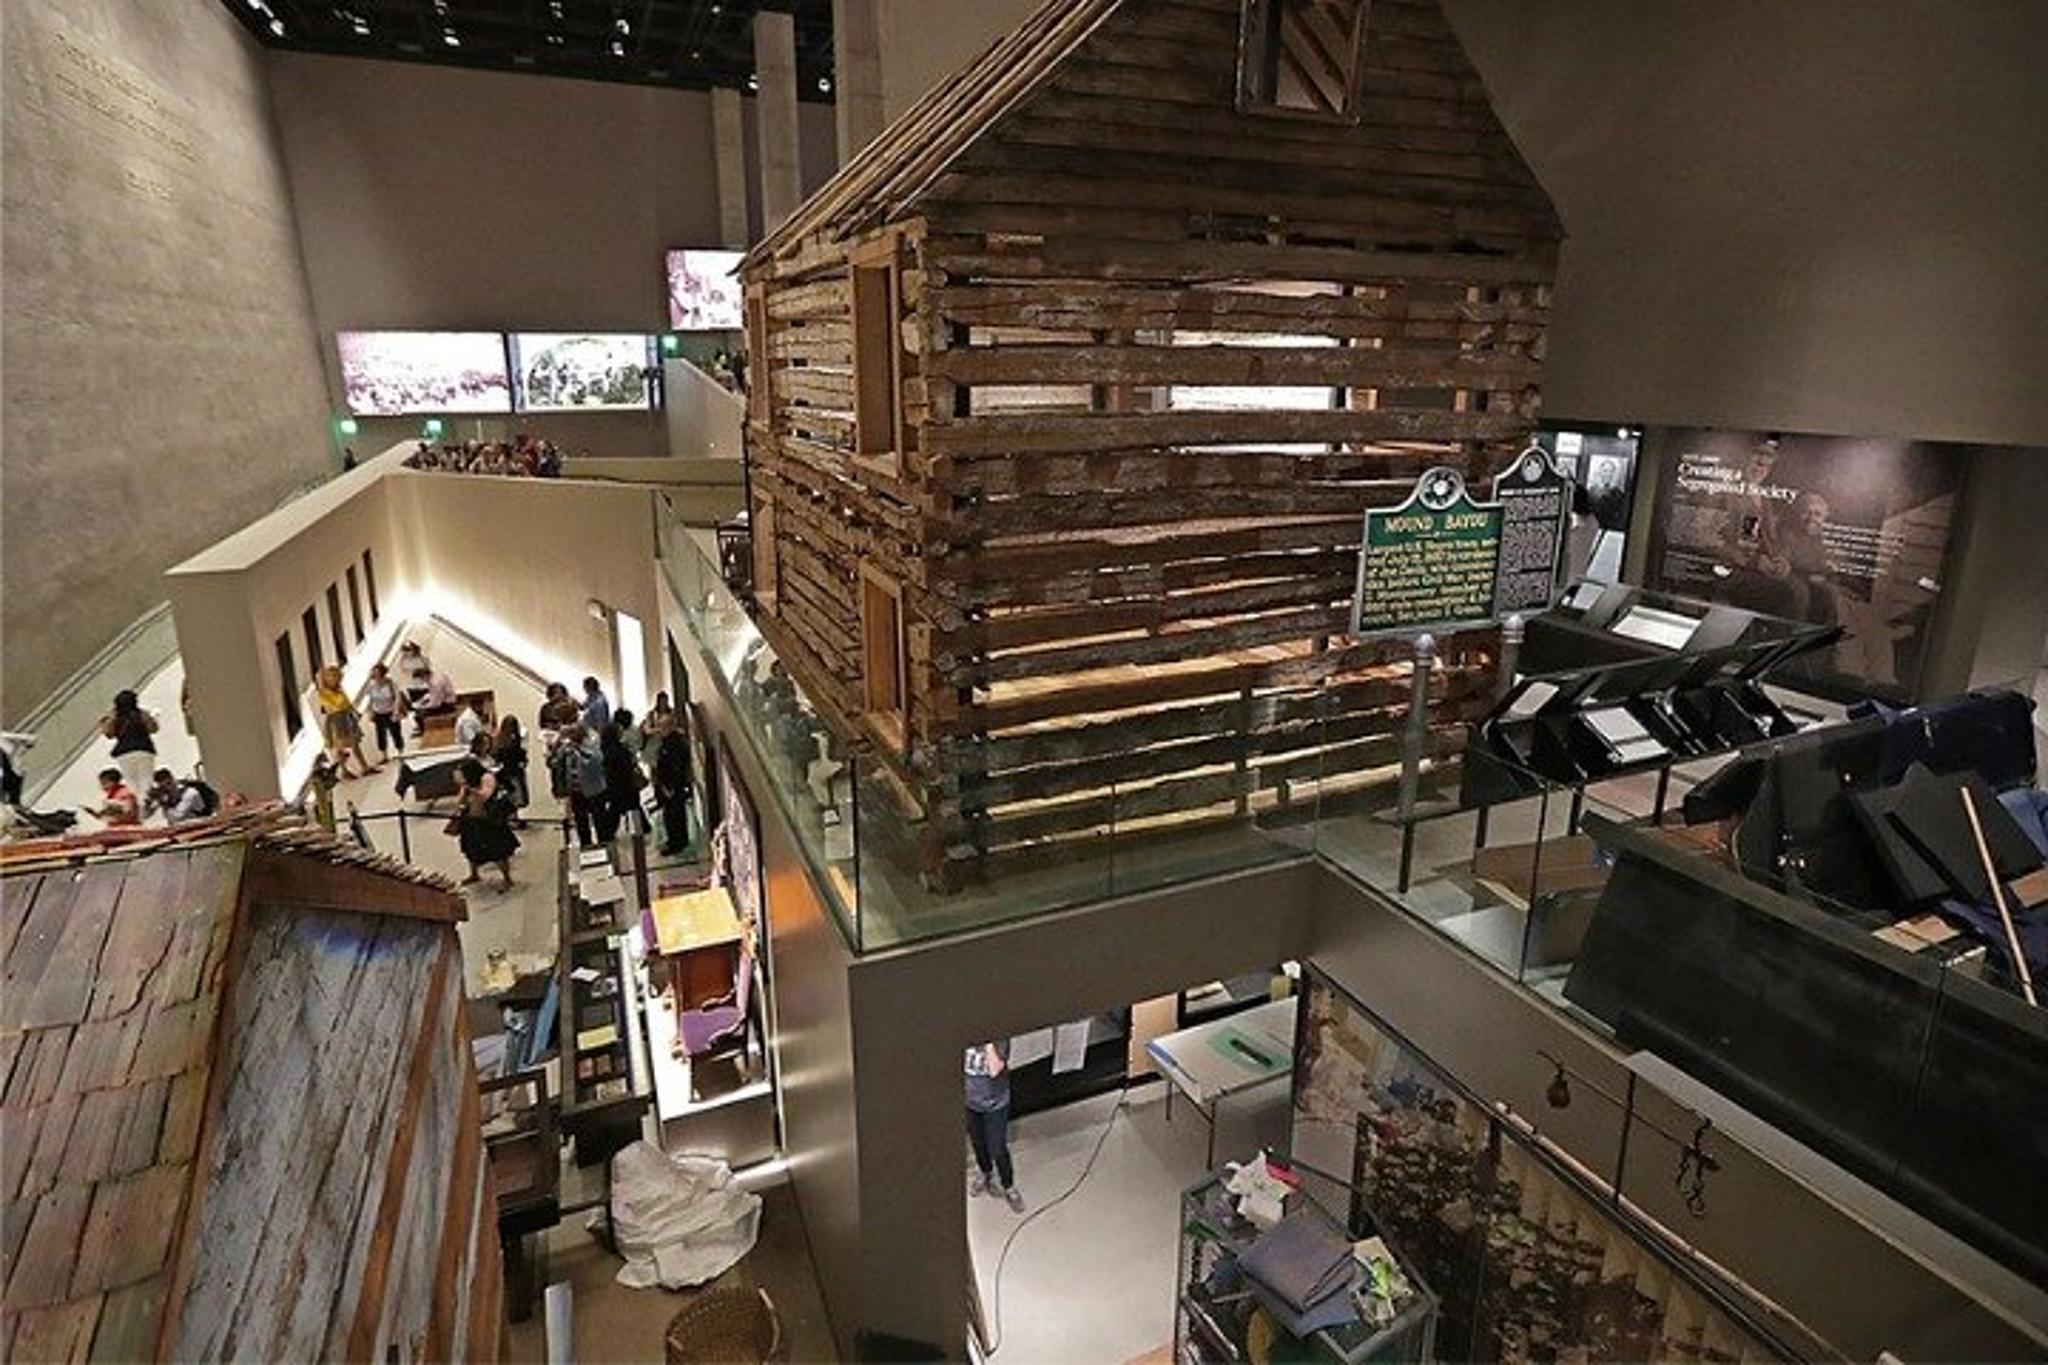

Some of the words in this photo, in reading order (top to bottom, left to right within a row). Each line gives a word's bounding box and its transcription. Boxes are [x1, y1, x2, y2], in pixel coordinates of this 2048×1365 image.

[1747, 482, 1798, 504] Society
[1385, 515, 1434, 532] MOUND
[1444, 513, 1489, 530] BAYOU
